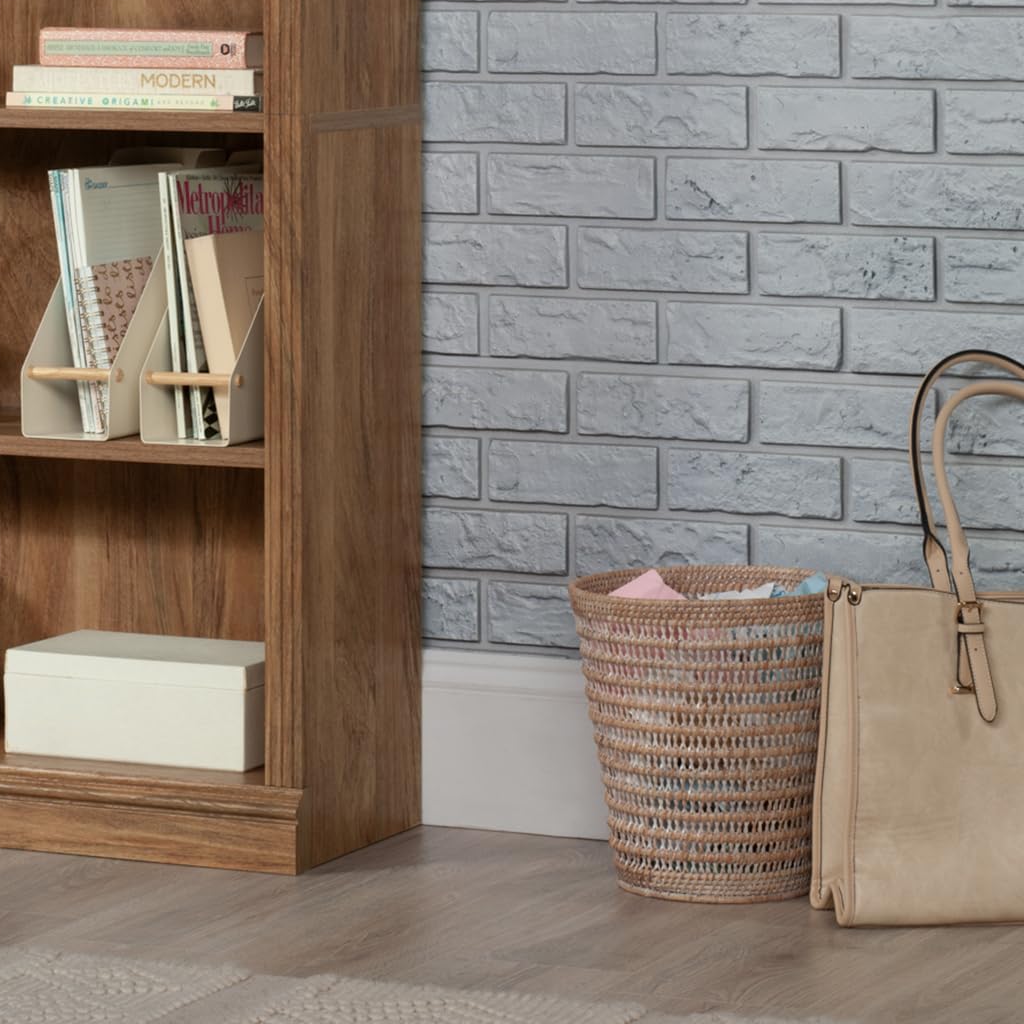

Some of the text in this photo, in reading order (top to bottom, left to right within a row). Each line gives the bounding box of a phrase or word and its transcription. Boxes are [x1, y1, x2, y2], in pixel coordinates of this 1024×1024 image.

[141, 73, 216, 89] MODERN
[36, 95, 94, 106] CREATIVE
[102, 96, 154, 107] ORIGAMI
